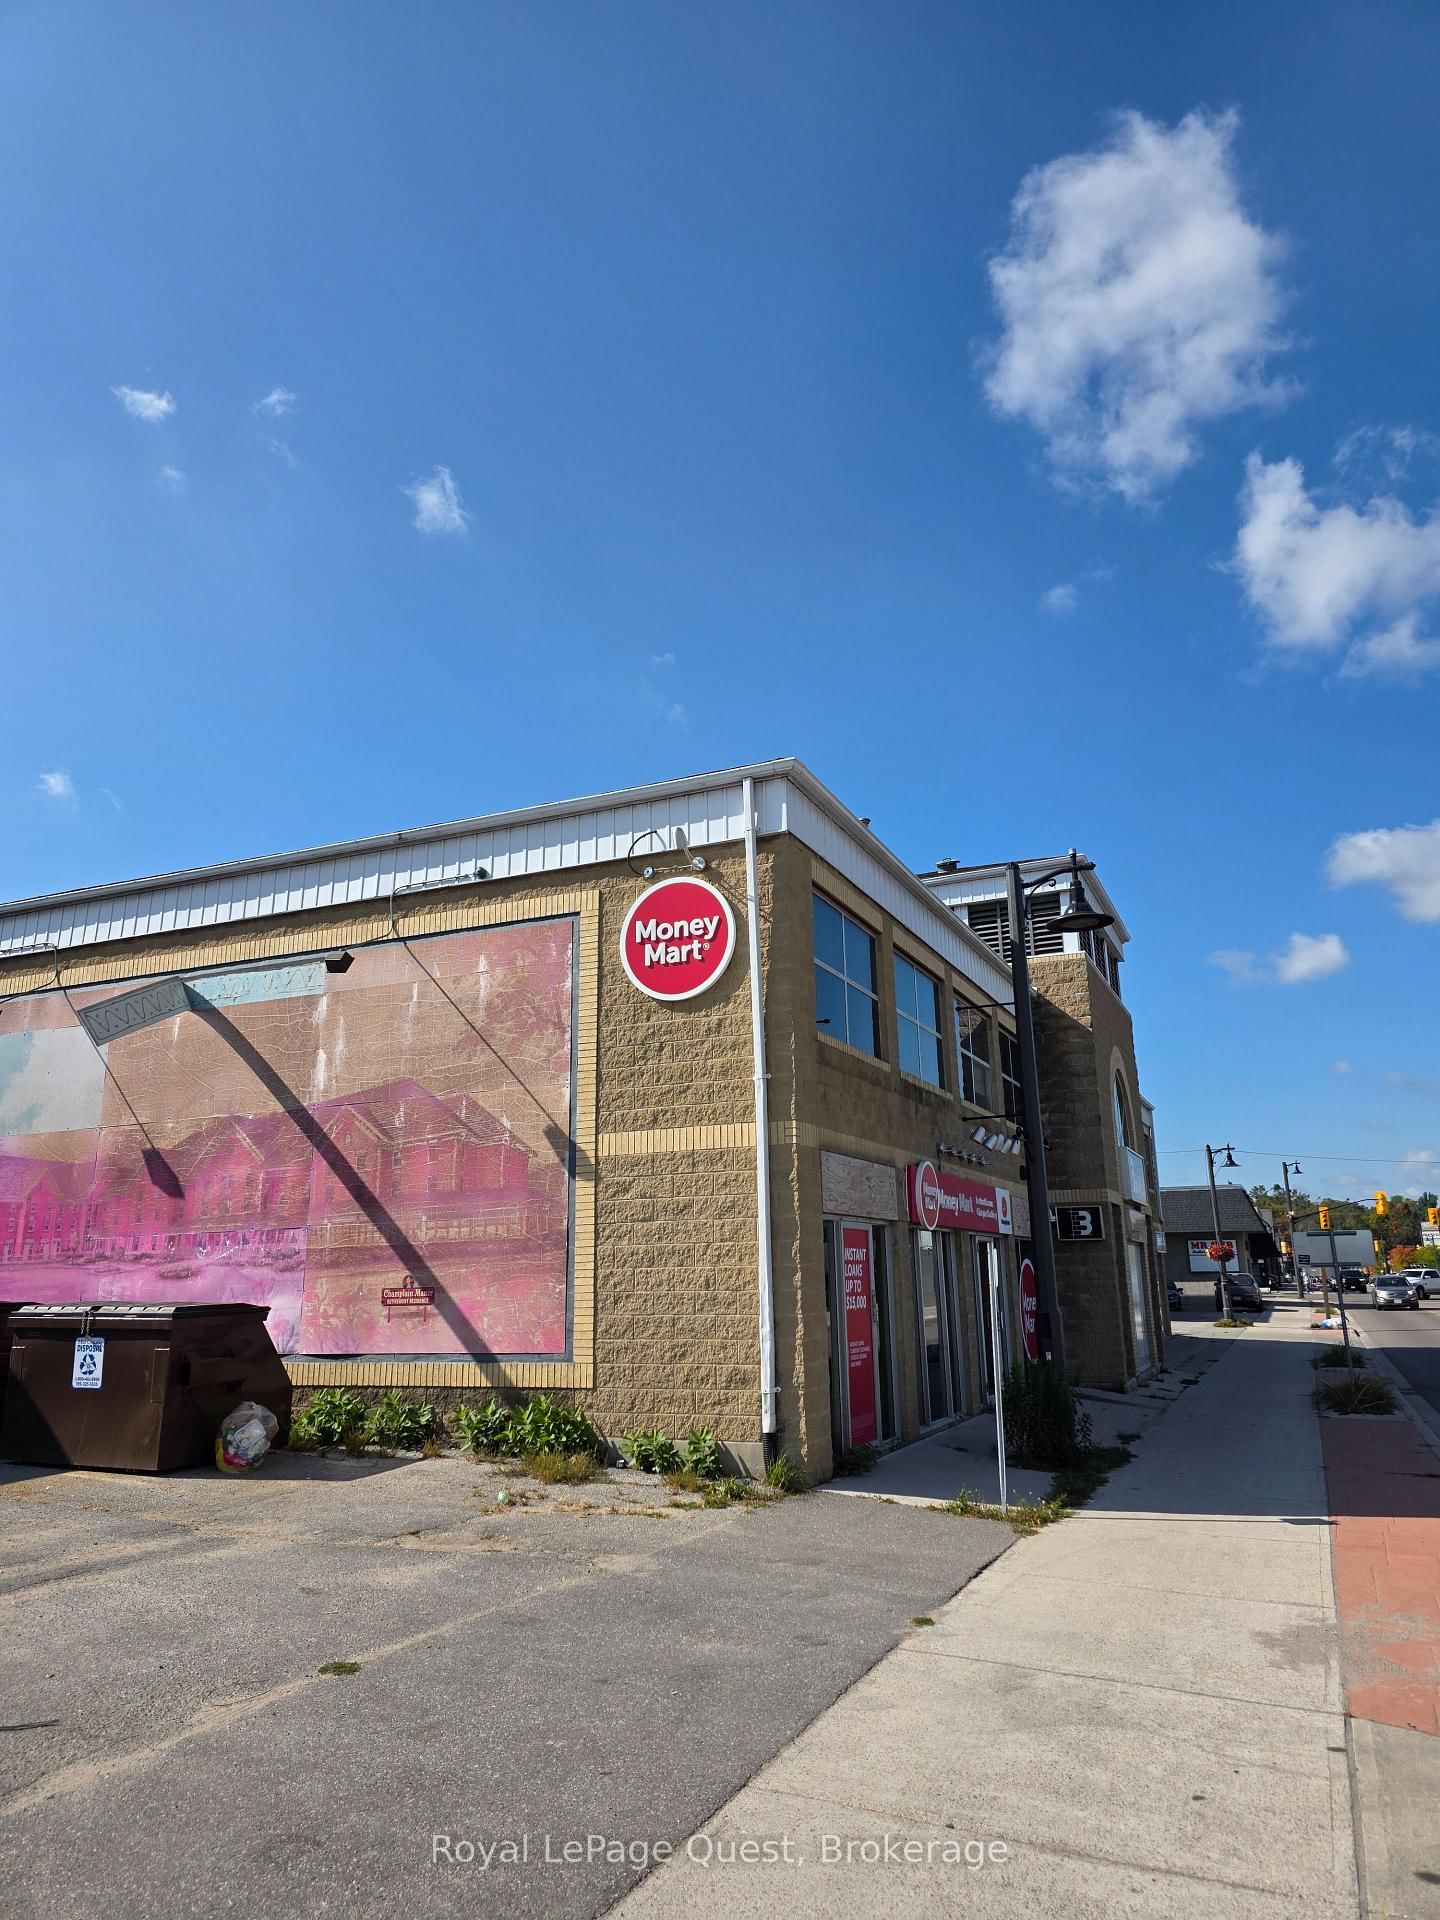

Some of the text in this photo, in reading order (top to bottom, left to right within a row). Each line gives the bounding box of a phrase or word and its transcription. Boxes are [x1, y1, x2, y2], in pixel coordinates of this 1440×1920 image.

[635, 915, 720, 943] Money
[939, 1189, 959, 1216] Money
[959, 1193, 974, 1214] Mart
[844, 1248, 867, 1261] INSTANT
[845, 1264, 863, 1277] LOANS
[383, 1288, 414, 1299] Champlain
[846, 1280, 862, 1293] UP TO
[846, 1295, 867, 1310] $15,000
[1022, 1292, 1037, 1312] Mone
[1024, 1313, 1036, 1334] Mar
[77, 1344, 103, 1352] DISPOSAL
